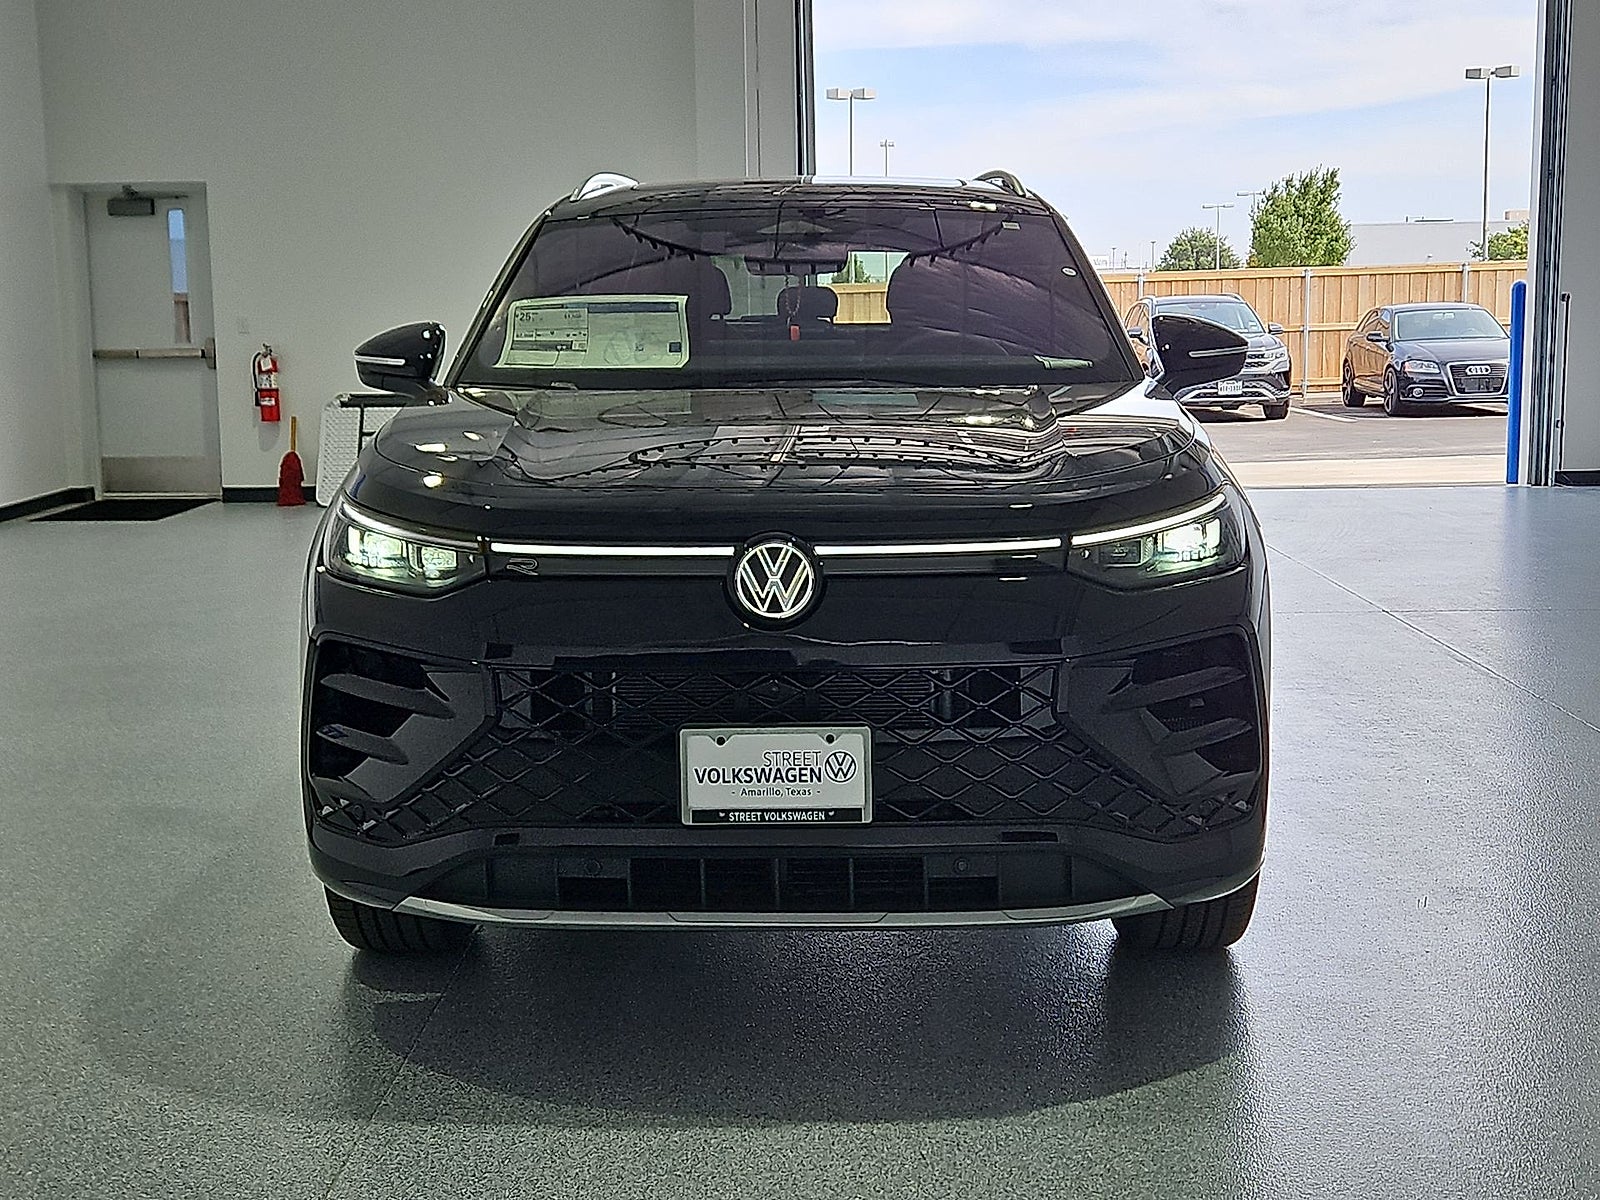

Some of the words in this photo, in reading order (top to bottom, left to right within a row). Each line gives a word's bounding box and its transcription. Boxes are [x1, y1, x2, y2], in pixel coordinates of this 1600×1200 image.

[763, 751, 822, 767] STREET
[693, 767, 823, 784] VOLKSWAGEN
[740, 787, 784, 798] Amarillo,
[787, 787, 812, 796] Texas
[728, 811, 762, 822] STREET
[764, 810, 826, 821] VOLKSWAGEN
